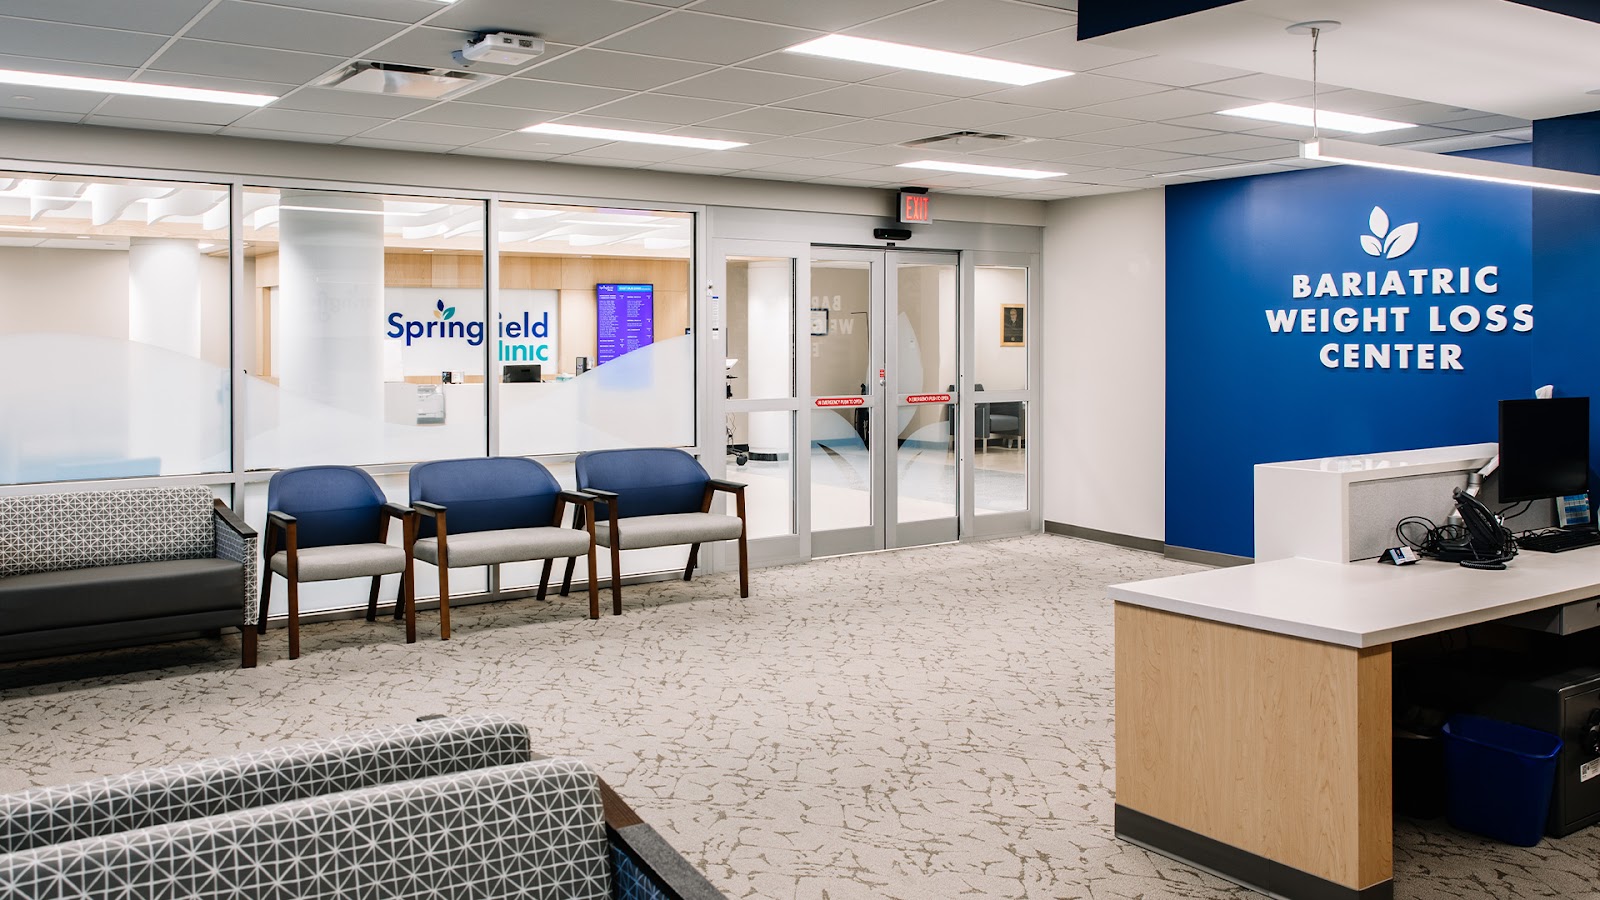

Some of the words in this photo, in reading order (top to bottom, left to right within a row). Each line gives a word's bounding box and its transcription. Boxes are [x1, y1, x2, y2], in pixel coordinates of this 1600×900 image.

[906, 195, 929, 221] EXIT
[1292, 266, 1498, 299] BARIATRIC
[387, 311, 548, 346] Springield
[1265, 306, 1410, 333] WEIGHT
[1429, 304, 1534, 333] LOSS
[498, 340, 549, 361] linic
[1319, 343, 1464, 370] CENTER
